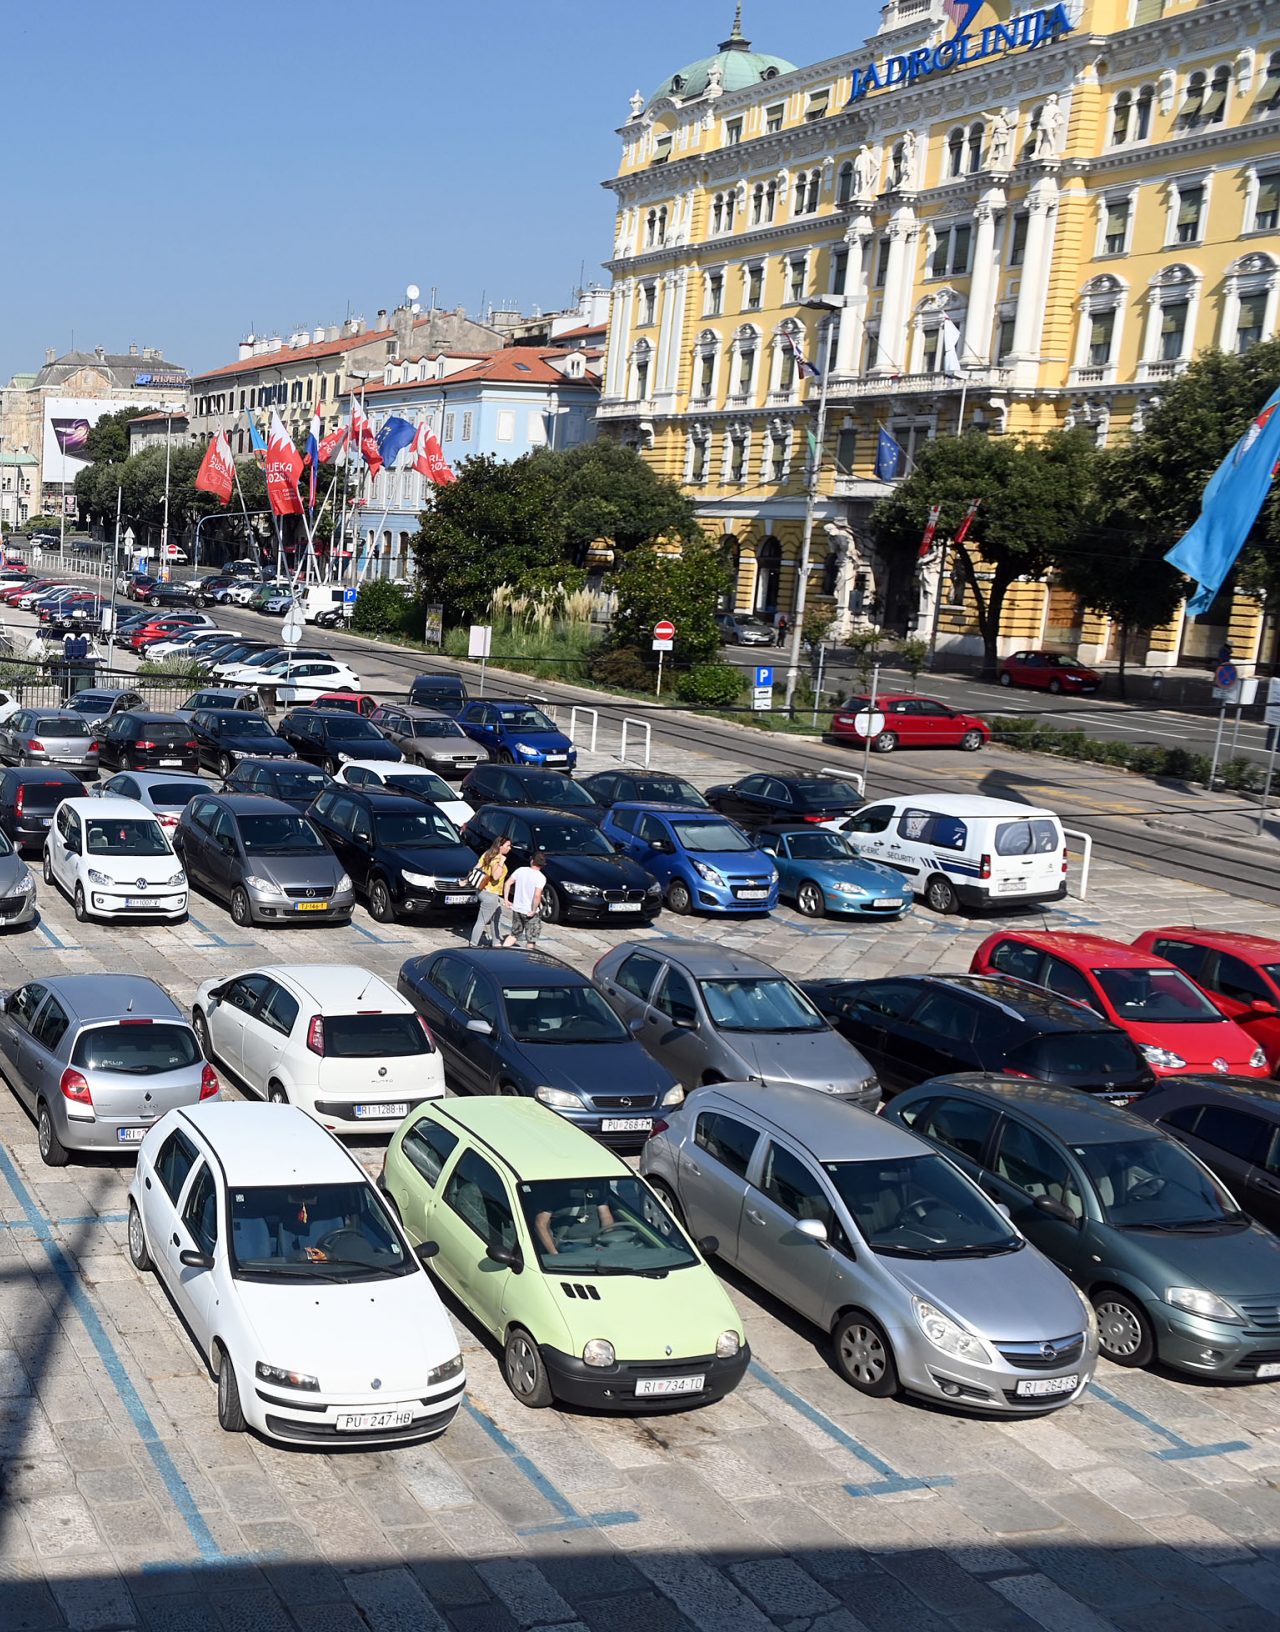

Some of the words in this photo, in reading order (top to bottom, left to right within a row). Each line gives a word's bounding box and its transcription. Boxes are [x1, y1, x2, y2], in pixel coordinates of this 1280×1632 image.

[847, 2, 1073, 103] JADROLINIJA
[760, 669, 769, 683] P
[887, 851, 916, 864] SECURITY
[361, 1105, 371, 1115] RI
[377, 1104, 404, 1115] 1288-H
[608, 1121, 619, 1130] PU
[623, 1120, 651, 1130] 268-FM
[125, 1129, 135, 1139] RI
[644, 1381, 656, 1393] RI
[1024, 1382, 1038, 1394] RI
[345, 1417, 363, 1428] PU
[370, 1411, 411, 1427] 247-HB
